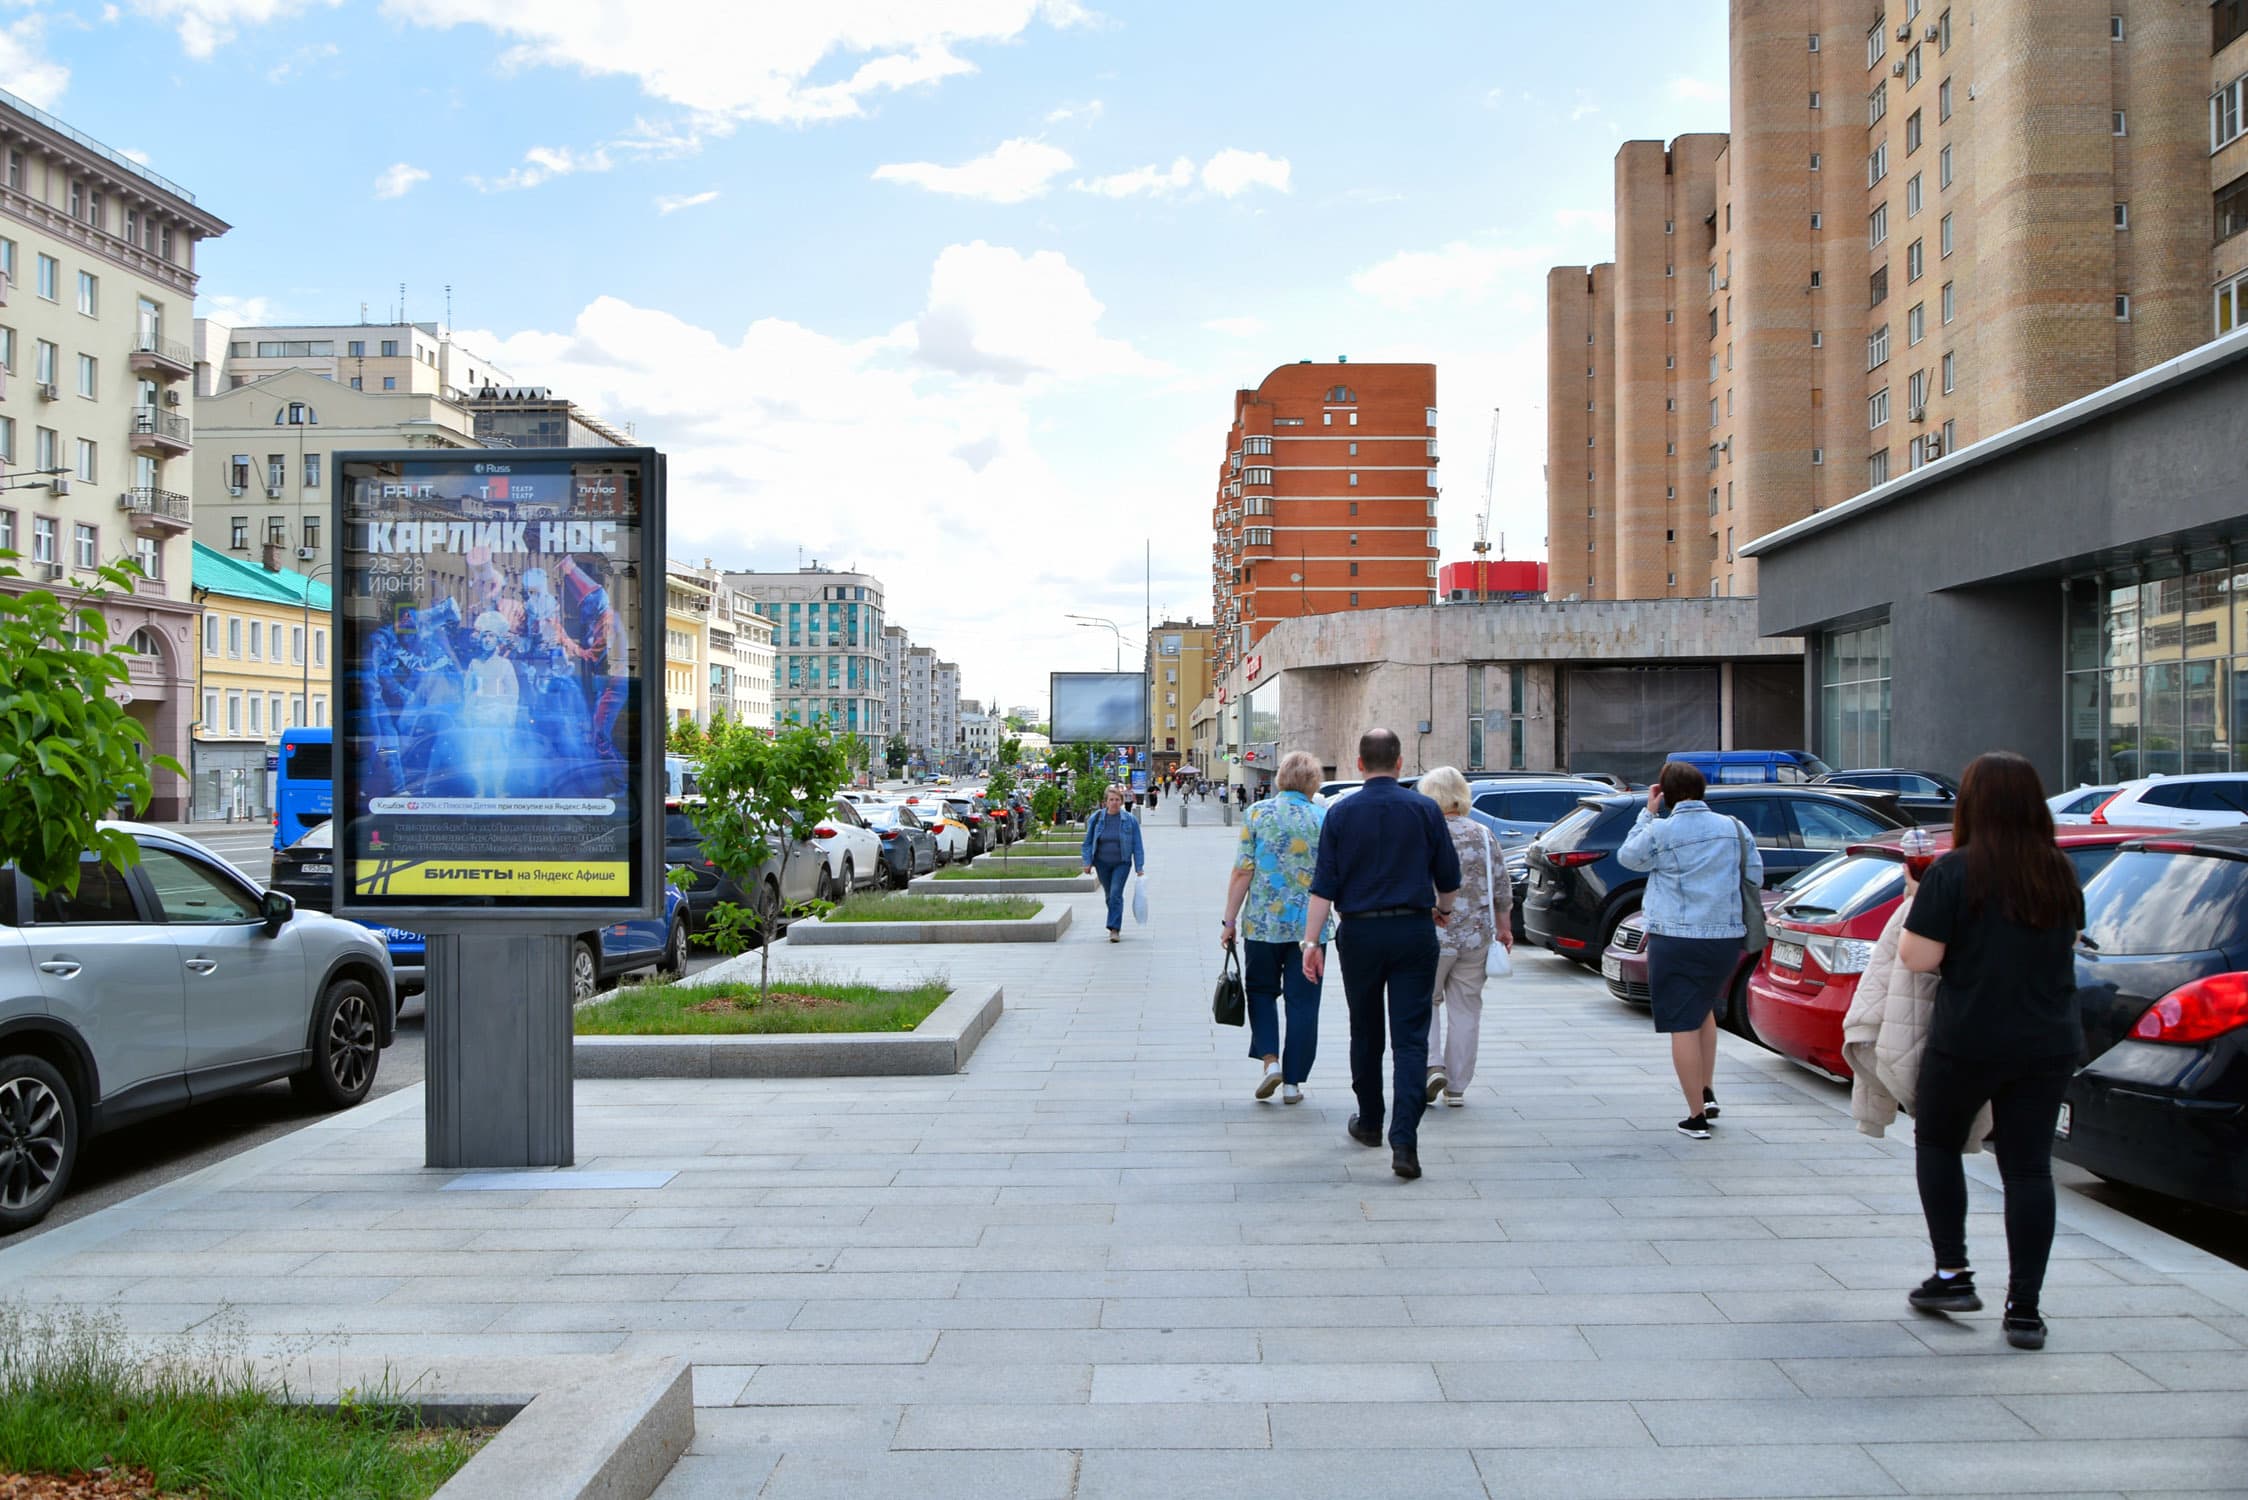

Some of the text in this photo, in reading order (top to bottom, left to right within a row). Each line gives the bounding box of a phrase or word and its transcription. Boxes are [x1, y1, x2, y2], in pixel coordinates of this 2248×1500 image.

[486, 464, 511, 473] Russ
[368, 521, 616, 553] КАРЛИК НОС
[368, 576, 424, 592] ИЮНЯ
[498, 803, 512, 811] при
[581, 802, 607, 811] Афише
[424, 869, 615, 882] БИЛЕТЫ на Яндекс Афише
